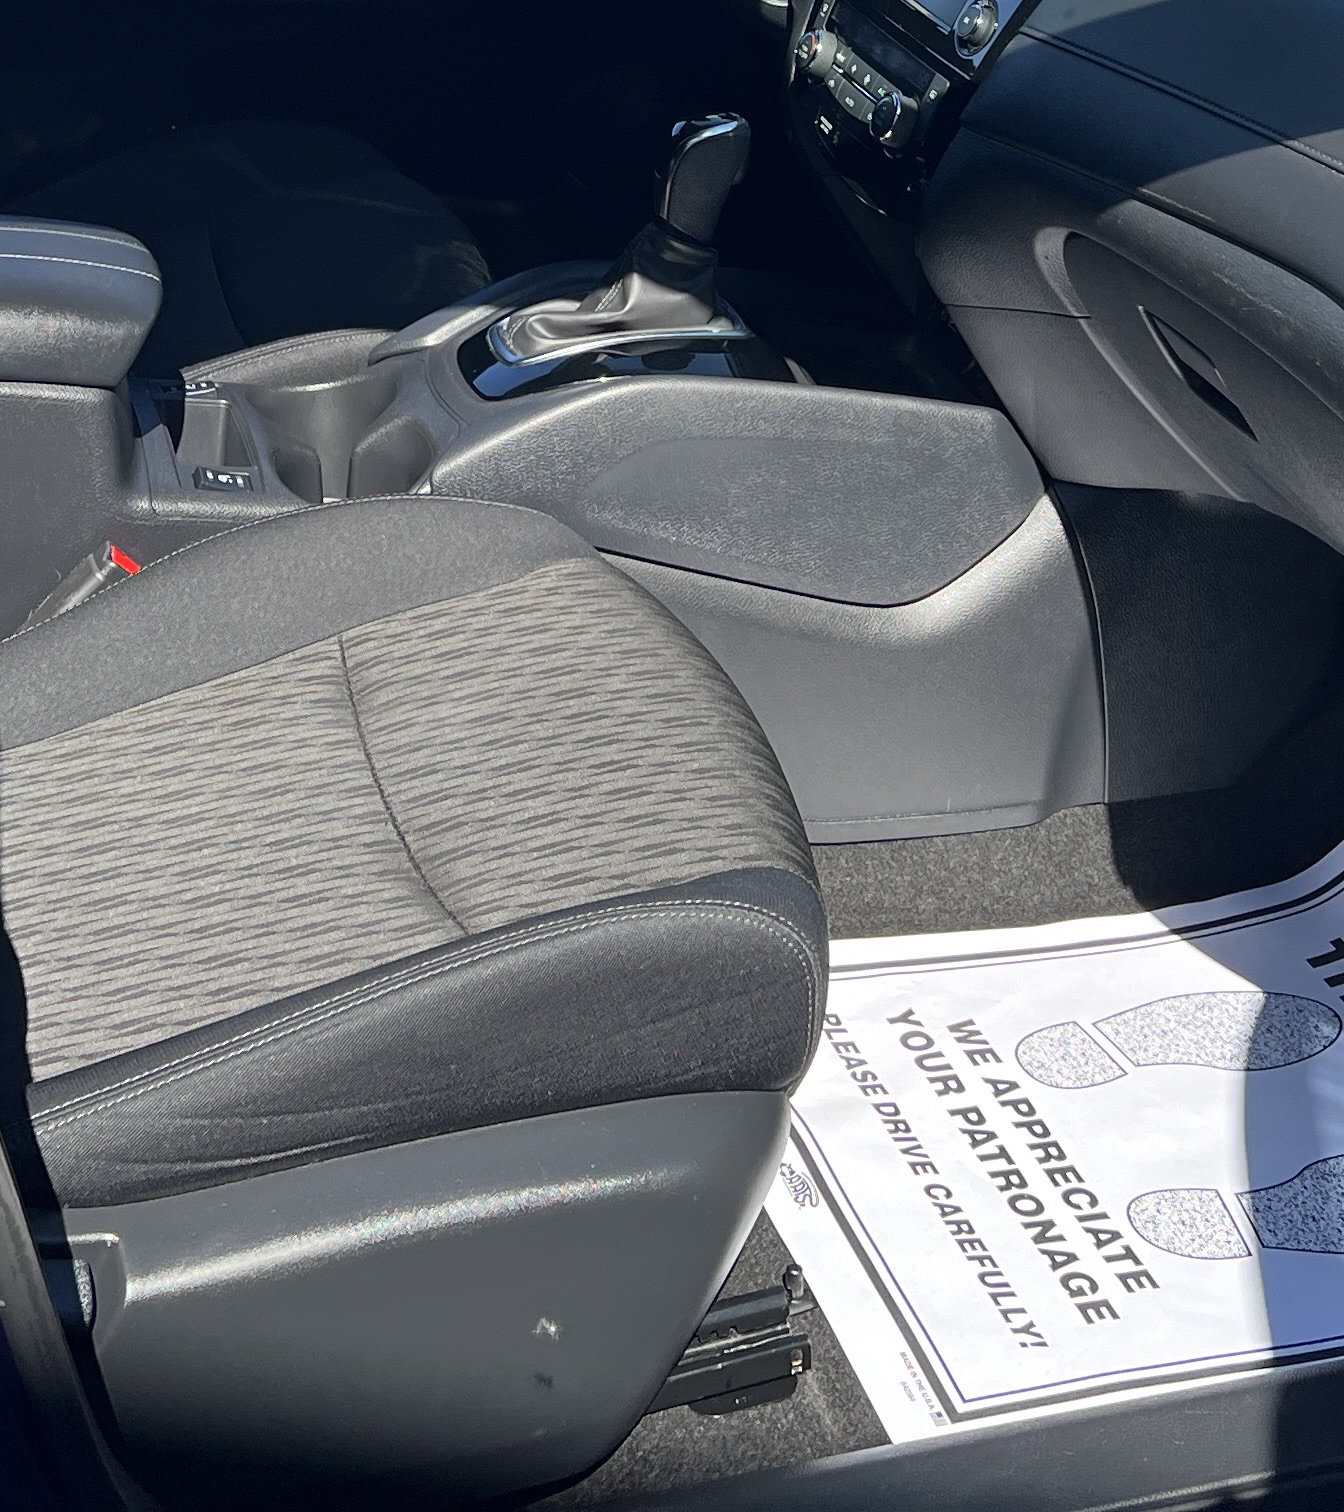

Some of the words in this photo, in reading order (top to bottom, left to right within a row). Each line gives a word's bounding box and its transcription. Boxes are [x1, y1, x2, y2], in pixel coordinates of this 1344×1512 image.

[823, 1013, 889, 1097] PLEASE
[871, 1101, 940, 1177] DRIVE
[923, 1183, 1049, 1349] CAREFULLY!
[886, 1007, 966, 1097] YOUR
[947, 1105, 1121, 1325] PATRONAGE
[946, 1018, 1003, 1067] WE
[981, 1076, 1160, 1294] APPRECIATE
